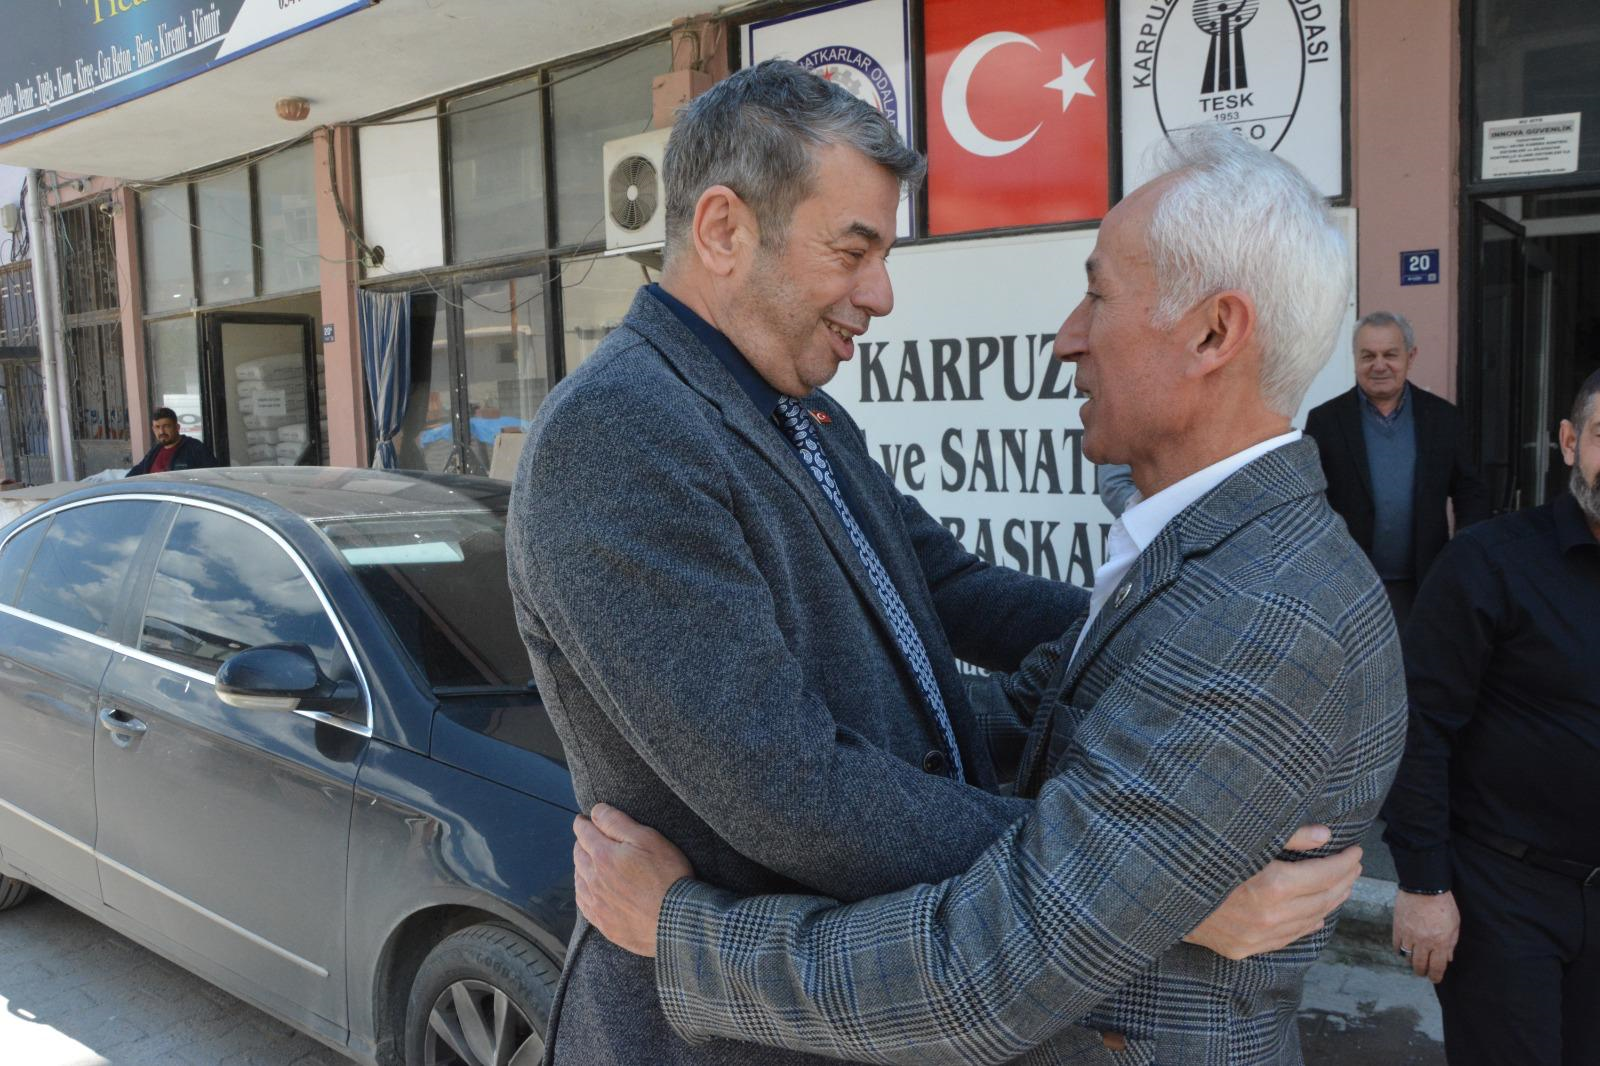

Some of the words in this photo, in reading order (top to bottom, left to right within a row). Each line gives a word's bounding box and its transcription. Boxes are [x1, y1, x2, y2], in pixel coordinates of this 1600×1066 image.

[56, 66, 74, 98] Kum
[97, 50, 112, 82] Gaz
[110, 45, 132, 77] Beton
[158, 16, 188, 59] Kiremit
[192, 2, 220, 45] Kömür
[1294, 0, 1329, 64] DASI
[1199, 92, 1254, 113] TESK
[1214, 111, 1240, 122] 1953
[1409, 255, 1430, 272] 20
[857, 332, 1092, 402] KARPUZ
[879, 443, 926, 492] ve
